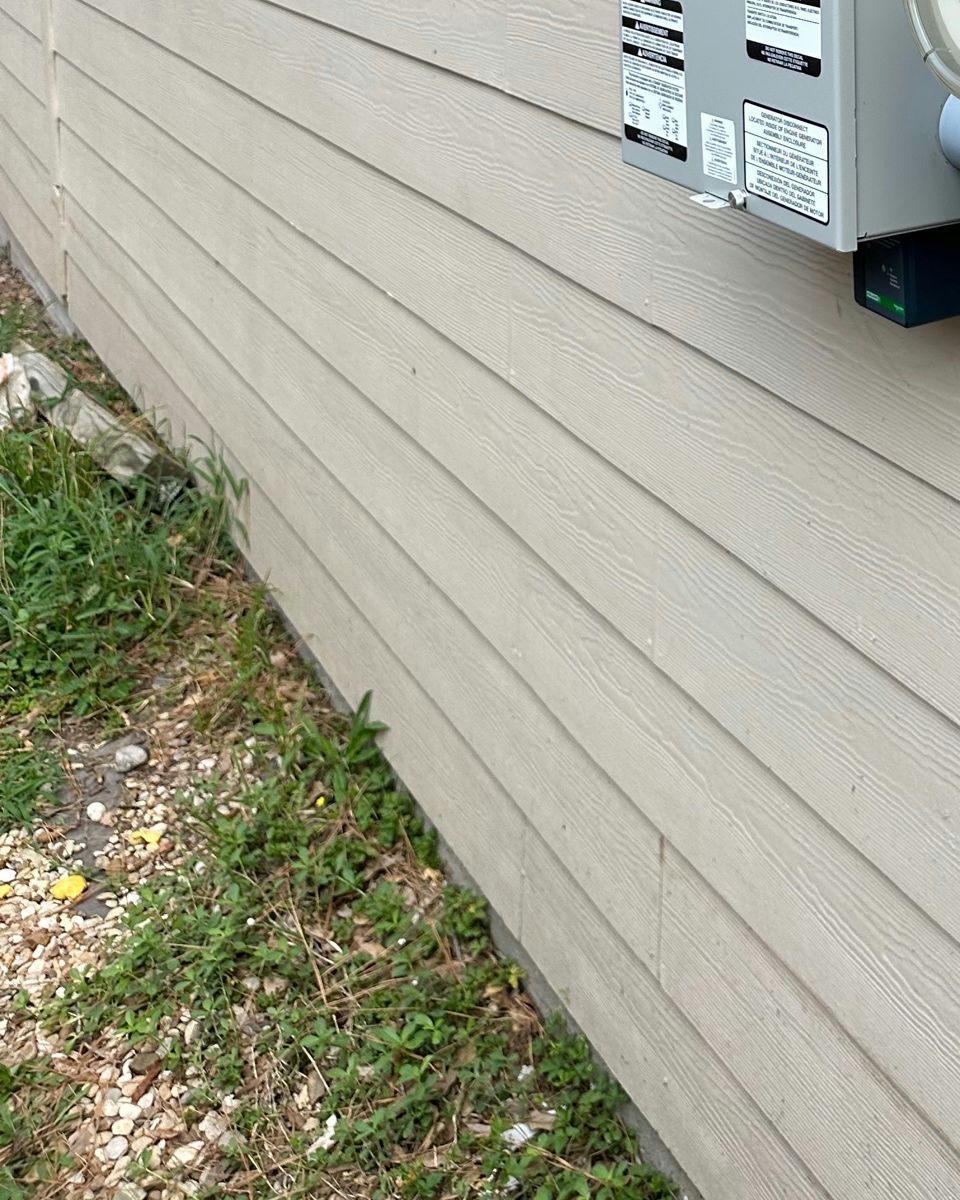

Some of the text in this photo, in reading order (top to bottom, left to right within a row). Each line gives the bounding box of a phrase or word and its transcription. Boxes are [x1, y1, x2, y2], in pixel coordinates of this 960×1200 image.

[748, 115, 764, 126] LOCATED
[798, 132, 822, 146] GENERATOR
[760, 111, 808, 132] GENERATOR DISCONNECT
[783, 135, 806, 149] ENCLOSURE
